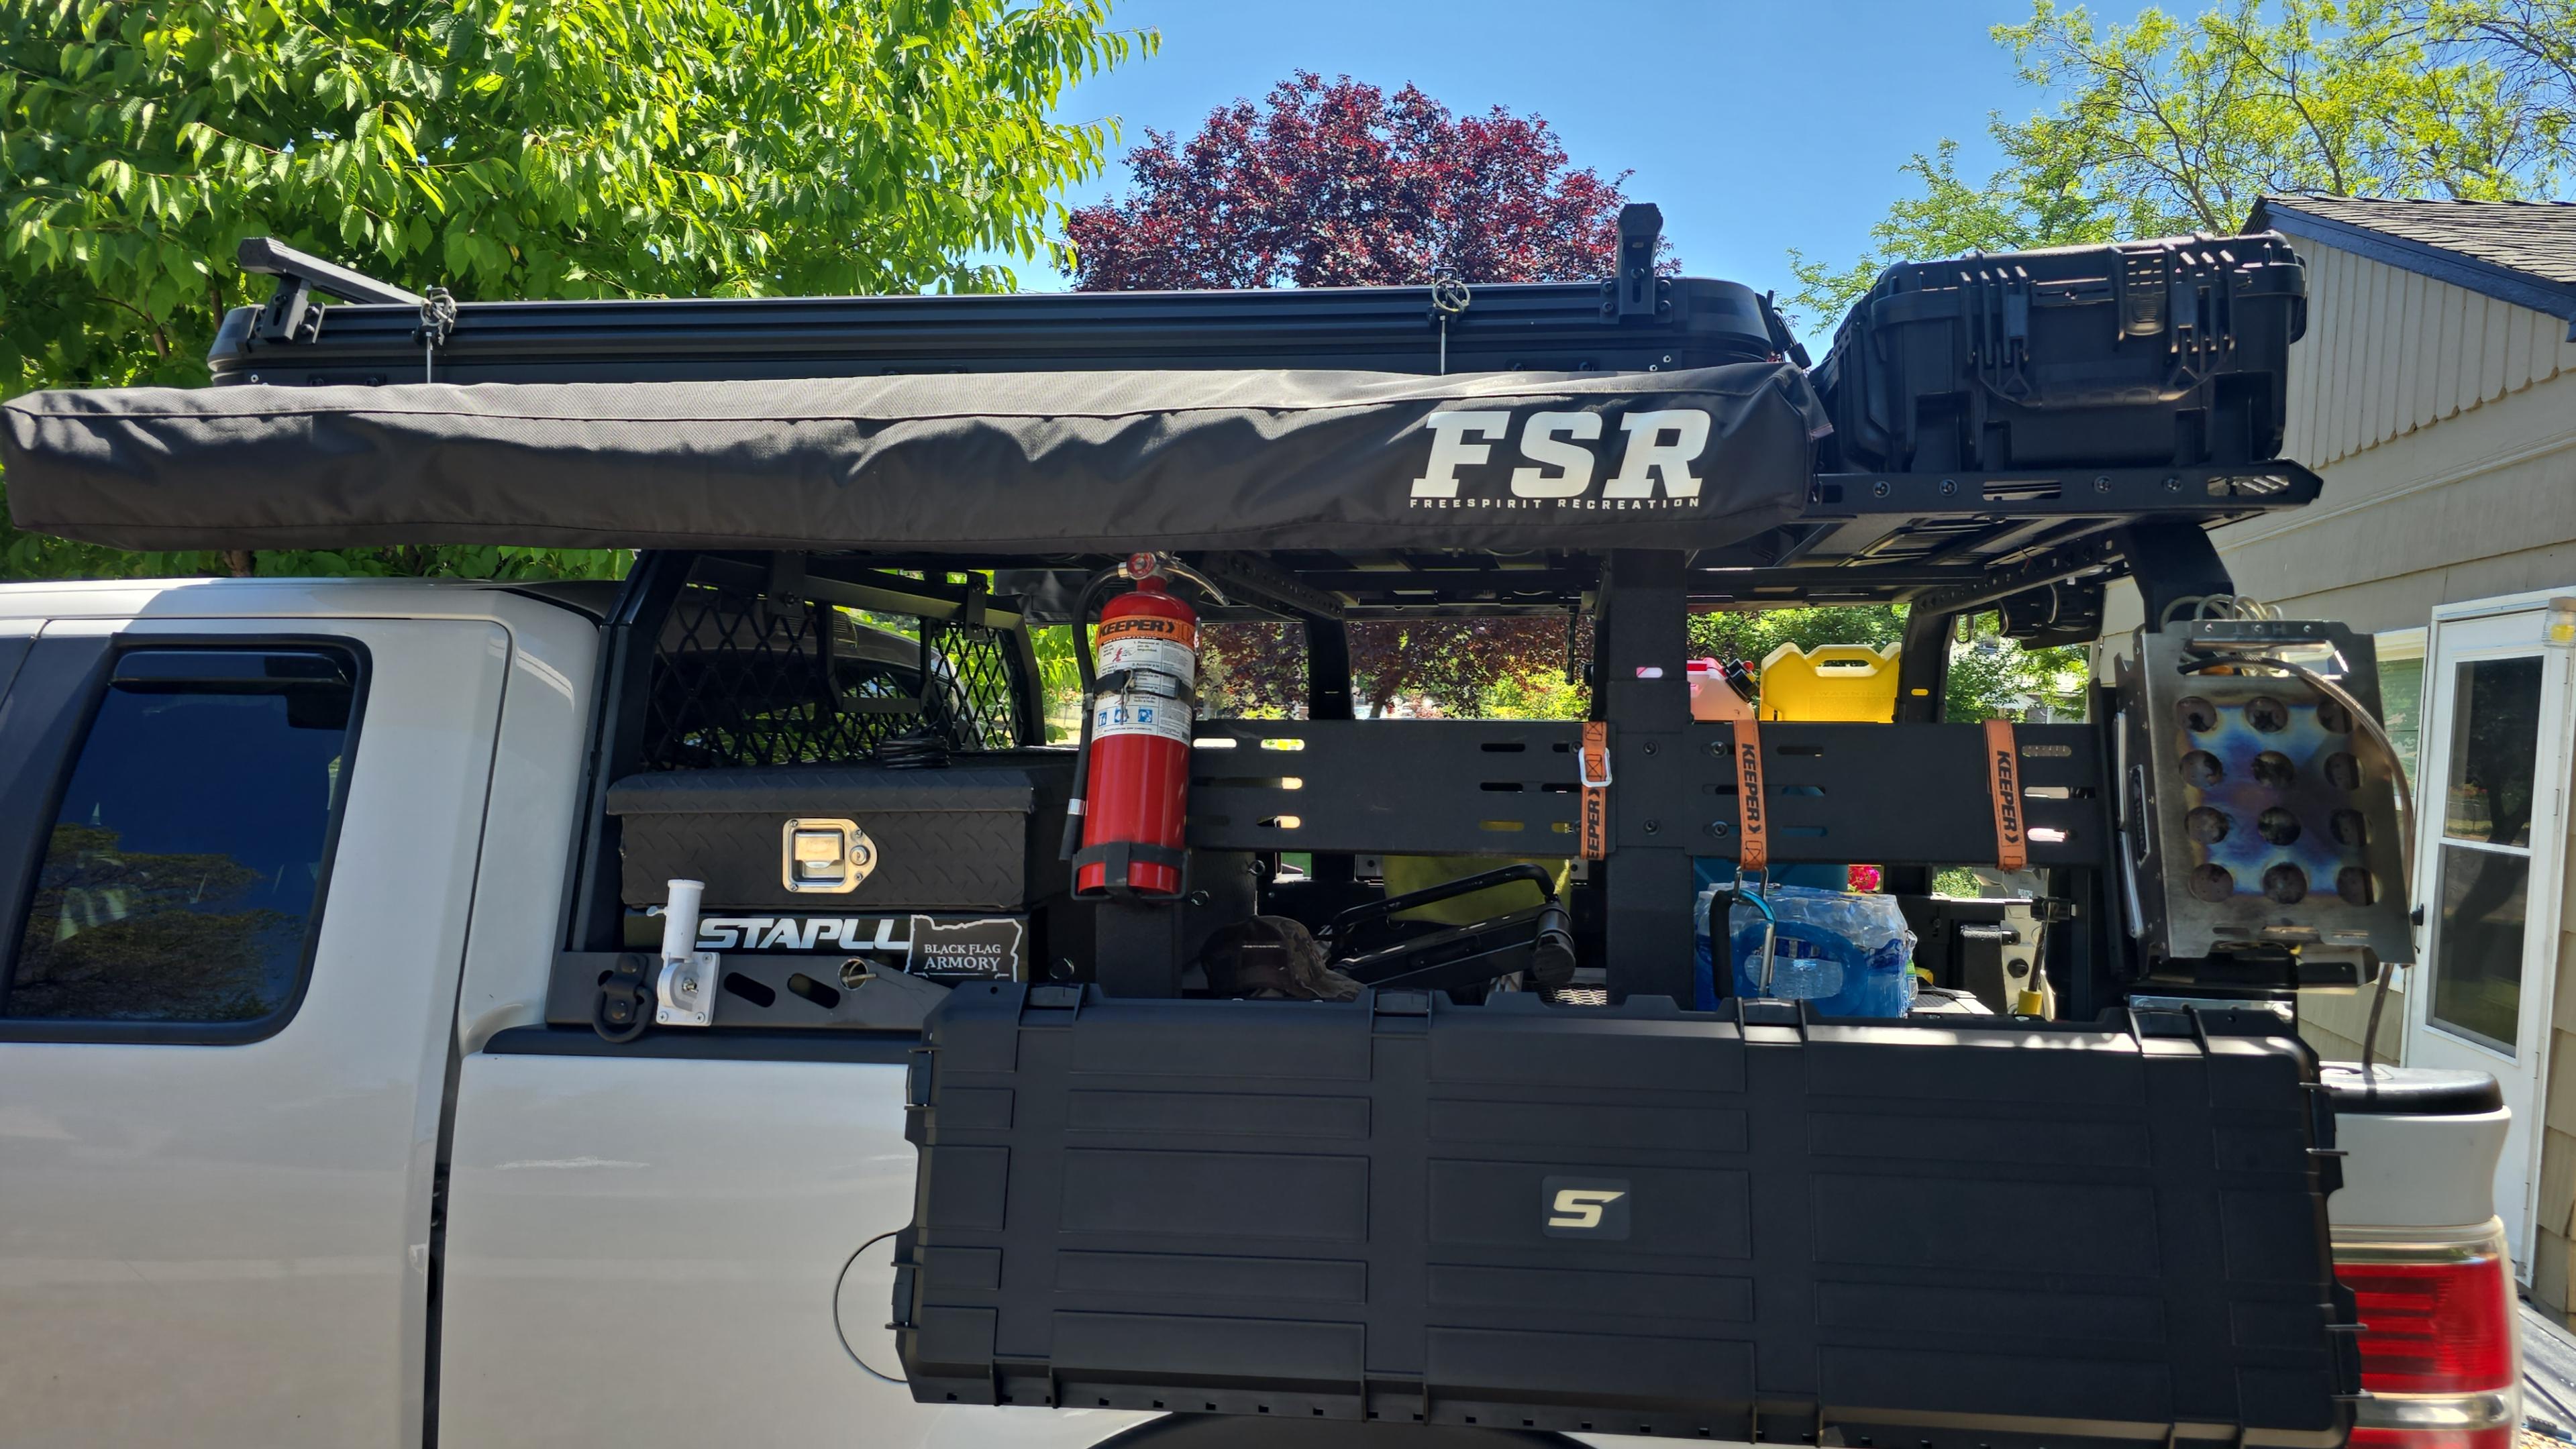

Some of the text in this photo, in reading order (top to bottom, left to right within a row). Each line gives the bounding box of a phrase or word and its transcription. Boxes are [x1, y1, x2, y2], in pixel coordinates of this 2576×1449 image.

[1410, 409, 1710, 498] FSR
[1410, 498, 1699, 510] FREESPIRIT RECREATION
[1100, 619, 1165, 636] KEEPER
[1742, 743, 1760, 821] KEEPER
[1997, 750, 2018, 832] KEEPER
[695, 918, 909, 949] STAPLL
[924, 944, 1001, 955] BLACK FLAG
[924, 956, 1000, 971] ARMORY
